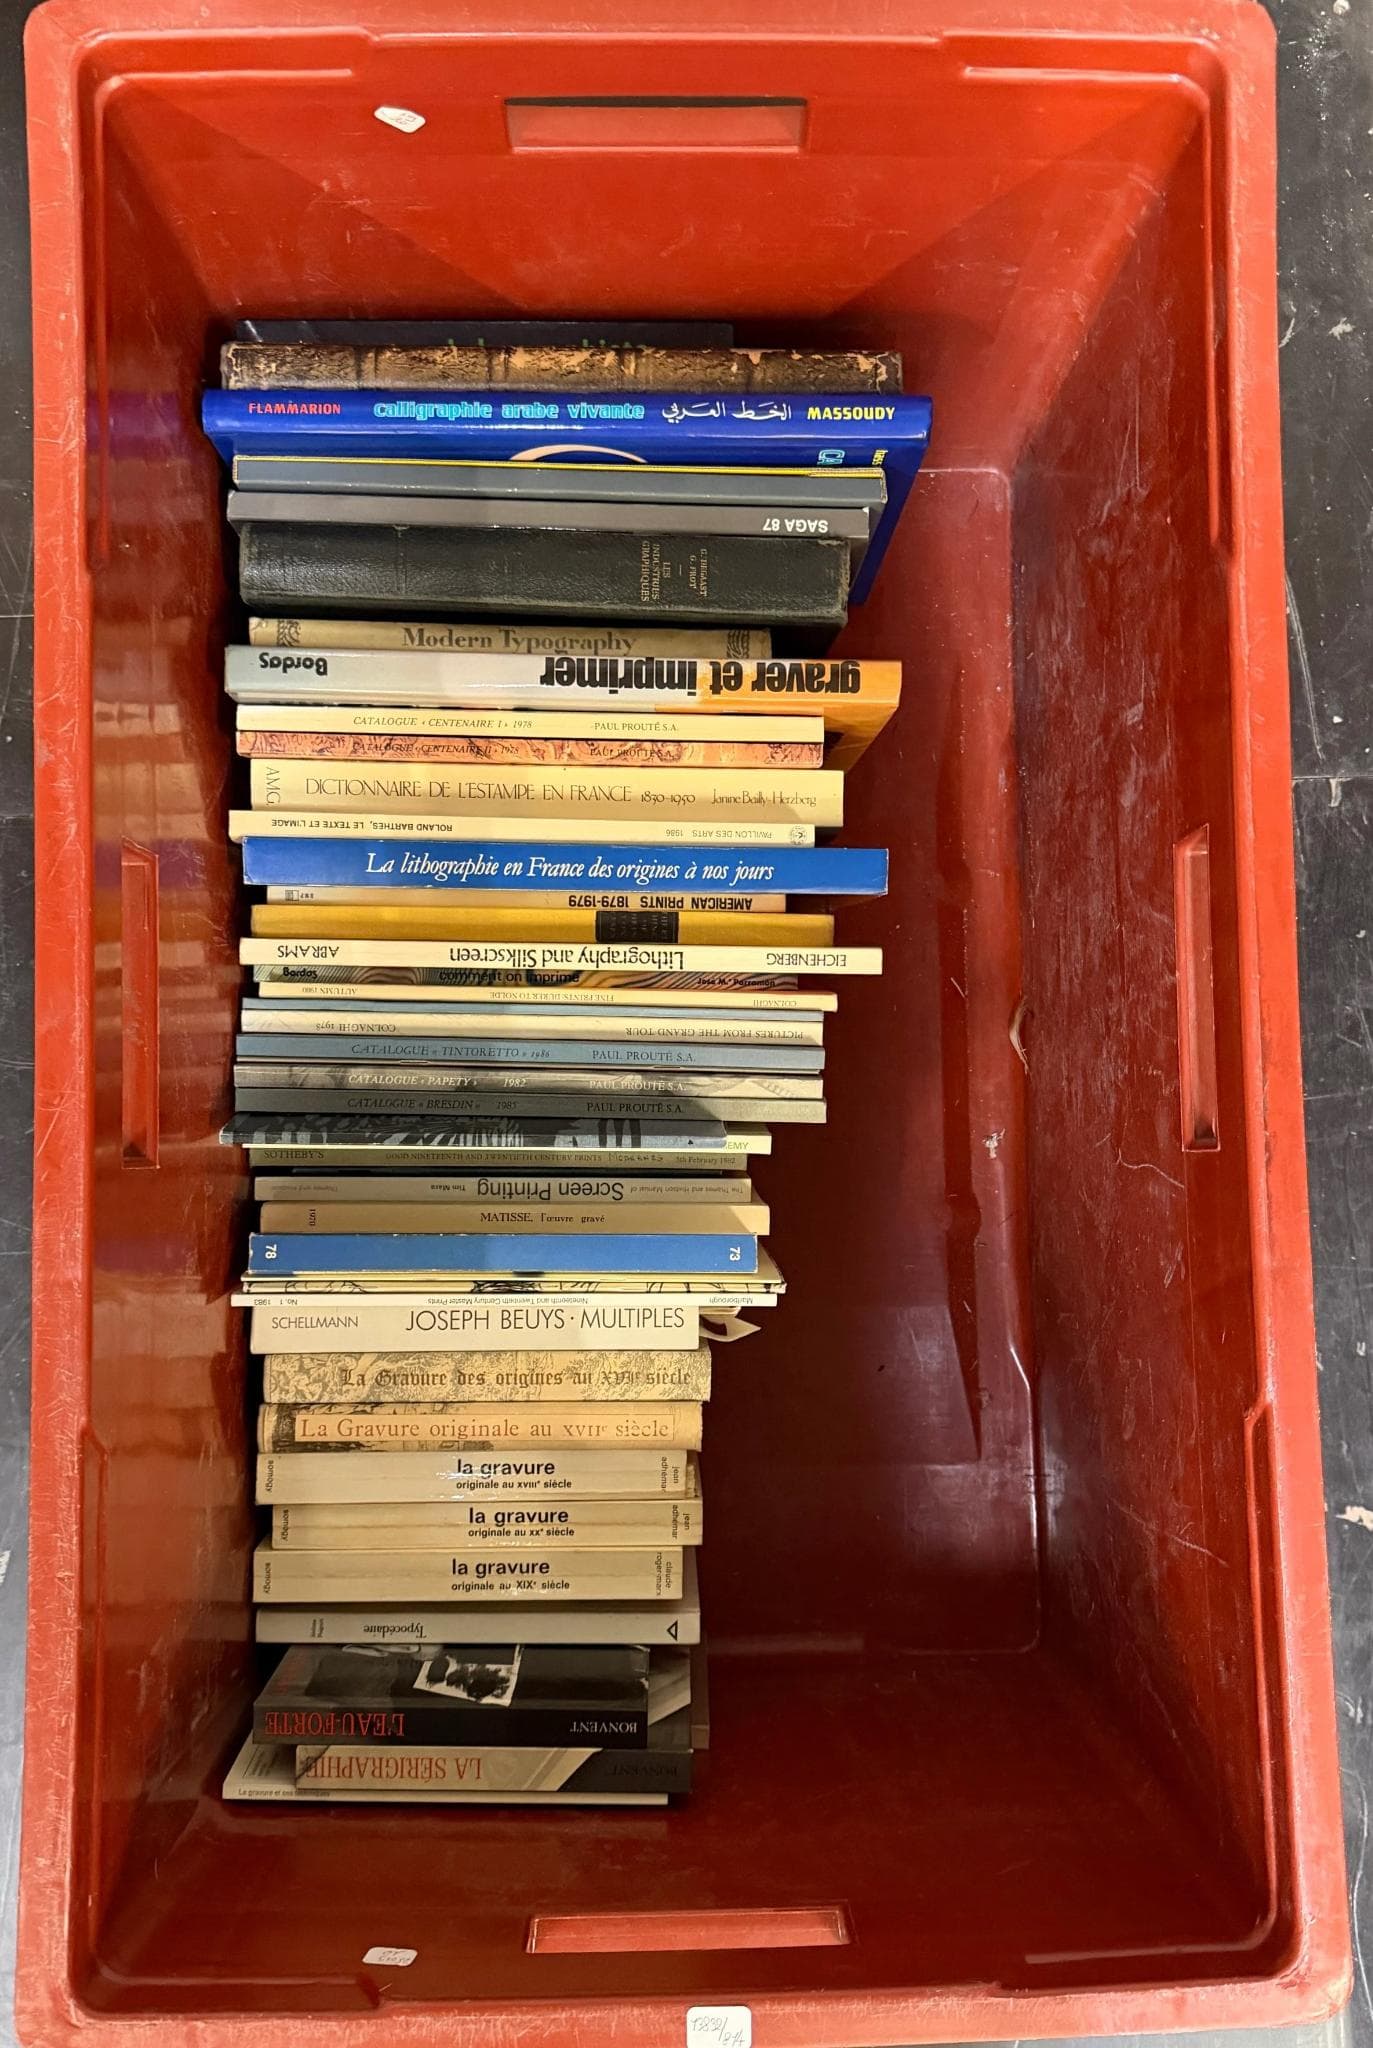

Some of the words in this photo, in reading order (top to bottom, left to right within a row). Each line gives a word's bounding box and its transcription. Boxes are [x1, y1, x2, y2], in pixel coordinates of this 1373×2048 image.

[249, 402, 341, 415] FLAMMARION
[373, 402, 492, 421] calligraphie
[502, 402, 559, 418] arabe
[567, 403, 645, 419] vivante
[806, 406, 895, 421] MASSOUDY
[763, 518, 782, 532] 87
[784, 519, 829, 534] SAGA
[640, 540, 650, 602] GRAPHIQUES
[652, 544, 660, 600] INDUSTRIES
[402, 628, 492, 648] Modern
[499, 629, 637, 653] Typography
[259, 652, 328, 676] Bordas
[540, 656, 698, 697] imprimer
[710, 661, 744, 694] et
[750, 660, 862, 694] graver
[353, 716, 418, 726] CATALOGUE
[428, 718, 494, 728] CENTENAIRE
[513, 720, 533, 729] 1978
[594, 722, 620, 732] PAUL
[622, 721, 661, 732] PROUTÉ
[352, 743, 413, 752] CATALOGUE
[590, 748, 614, 757] PAUL
[306, 778, 422, 798] DICTIONNAIRE
[429, 782, 450, 798] DE
[458, 782, 535, 800] L'ESTAMPE
[543, 784, 564, 801] EN
[570, 784, 632, 802] FRANCE
[641, 791, 696, 806] 1830-1950
[712, 788, 742, 806] Janine
[742, 790, 817, 807] Bailly-Herzberg
[272, 819, 306, 828] L'IMAGE
[310, 820, 322, 828] ET
[322, 820, 350, 830] TEXTE
[353, 822, 364, 830] LE
[370, 822, 414, 832] BARTHES,
[416, 824, 452, 832] ROLAND
[666, 828, 684, 837] 1986
[692, 830, 714, 838] ARTS
[716, 830, 733, 838] DES
[734, 830, 772, 840] PAVILLON
[366, 853, 394, 874] La
[400, 854, 500, 884] lithographie
[504, 862, 524, 876] en
[527, 857, 585, 877] France
[588, 856, 612, 878] des
[616, 862, 680, 885] origines
[685, 862, 696, 880] à
[702, 866, 728, 880] nos
[730, 863, 774, 885] jours
[568, 895, 629, 908] 1879-1979
[640, 896, 684, 910] PRINTS
[690, 896, 752, 910] AMERICAN
[277, 946, 340, 958] ABRAMS
[450, 947, 538, 968] Silkscreen
[542, 948, 574, 968] and
[578, 950, 684, 970] Lithography
[766, 952, 847, 967] EICHENBERG
[282, 966, 318, 978] Bordas
[439, 970, 502, 982] comment
[505, 972, 522, 982] on
[526, 968, 580, 985] imprime
[320, 987, 358, 995] AUTUMN
[490, 992, 518, 1000] NOLDE
[596, 994, 614, 1002] FINE
[753, 1000, 797, 1008] COLNAGHI
[339, 1022, 396, 1032] COLNAGHI
[625, 1027, 655, 1036] TOUR
[658, 1028, 695, 1037] GRAND
[699, 1028, 720, 1038] THE
[723, 1029, 752, 1038] FROM
[755, 1030, 804, 1039] PICTURES
[352, 1044, 429, 1056] CATALOGUE
[442, 1046, 519, 1058] TINTORETTO
[592, 1050, 623, 1060] PAUL
[626, 1050, 673, 1062] PROUTÉ
[348, 1074, 418, 1086] CATALOGUE
[428, 1076, 472, 1086] PAPETY
[503, 1078, 526, 1088] 1982
[589, 1080, 618, 1090] PAUL
[347, 1098, 416, 1108] CATALOGUE
[426, 1100, 474, 1110] BRESDIN
[587, 1102, 616, 1112] PAUL
[619, 1101, 664, 1113] PROUTÉ
[264, 1150, 324, 1159] SOTHEBY'S
[534, 1154, 574, 1162] CENTURY
[688, 1157, 718, 1166] February
[430, 1184, 450, 1192] Mara
[477, 1178, 550, 1200] Printing
[558, 1182, 624, 1200] Screen
[480, 1212, 534, 1224] MATISSE,
[541, 1212, 574, 1223] l'œuvre
[581, 1214, 605, 1224] gravé
[265, 1244, 277, 1259] 78
[730, 1246, 740, 1261] 73
[474, 1296, 500, 1305] Century
[502, 1296, 534, 1304] Twentieth
[550, 1296, 588, 1304] Nineteenth
[709, 1296, 753, 1306] Marlborough
[272, 1316, 358, 1329] SCHELLMANN
[406, 1310, 489, 1331] JOSEPH
[501, 1308, 564, 1330] BEUYS
[580, 1308, 684, 1330] MULTIPLES
[341, 1369, 366, 1387] La
[374, 1370, 448, 1387] Gravure
[457, 1368, 486, 1386] des
[496, 1370, 564, 1388] origines
[572, 1373, 592, 1386] au
[646, 1368, 692, 1386] siècle
[300, 1419, 328, 1438] La
[337, 1418, 419, 1438] Gravure
[429, 1418, 519, 1440] originale
[530, 1424, 551, 1436] au
[616, 1420, 670, 1438] siècle
[457, 1459, 472, 1476] la
[480, 1462, 555, 1479] gravure
[672, 1466, 680, 1484] jean
[265, 1460, 274, 1492] somogy
[456, 1480, 499, 1490] originale
[544, 1479, 572, 1489] siècle
[468, 1507, 486, 1524] la
[494, 1510, 569, 1526] gravure
[682, 1513, 690, 1530] jean
[468, 1528, 511, 1538] originale
[546, 1527, 575, 1537] siècle
[452, 1558, 468, 1576] la
[475, 1562, 550, 1578] gravure
[655, 1552, 663, 1596] roger-marx
[264, 1562, 272, 1594] somogy
[451, 1582, 494, 1592] originale
[499, 1582, 512, 1590] au
[542, 1580, 570, 1590] siècle
[363, 1623, 427, 1638] Typocédaire
[265, 1712, 406, 1737] L'EAU-FORTE
[570, 1720, 637, 1734] BONVENT
[305, 1756, 446, 1784] SÉRIGRAPHIE
[454, 1758, 482, 1779] LA
